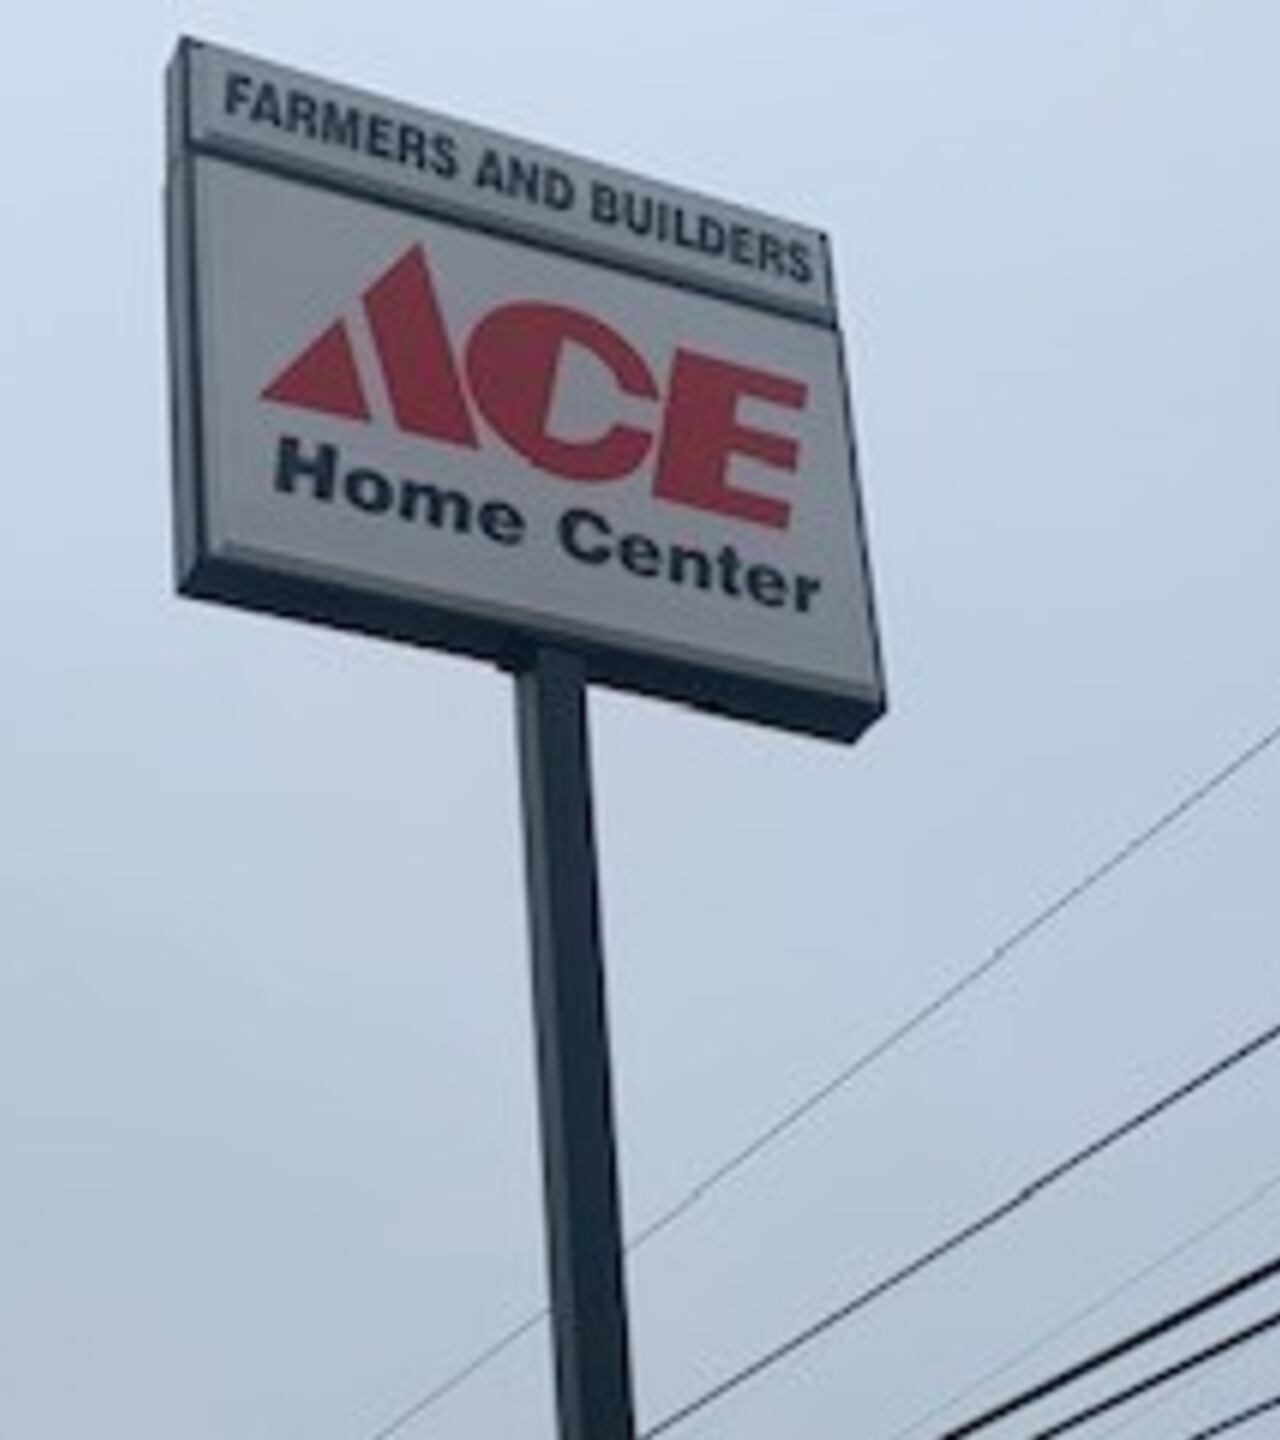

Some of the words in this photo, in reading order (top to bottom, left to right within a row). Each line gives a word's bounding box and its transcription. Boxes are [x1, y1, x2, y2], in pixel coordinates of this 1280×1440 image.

[225, 72, 458, 181] FARMERS
[474, 148, 575, 213] AND
[590, 184, 814, 286] BUILDERS
[260, 242, 808, 530] ACE
[273, 435, 526, 547] Home
[557, 508, 822, 614] Center
